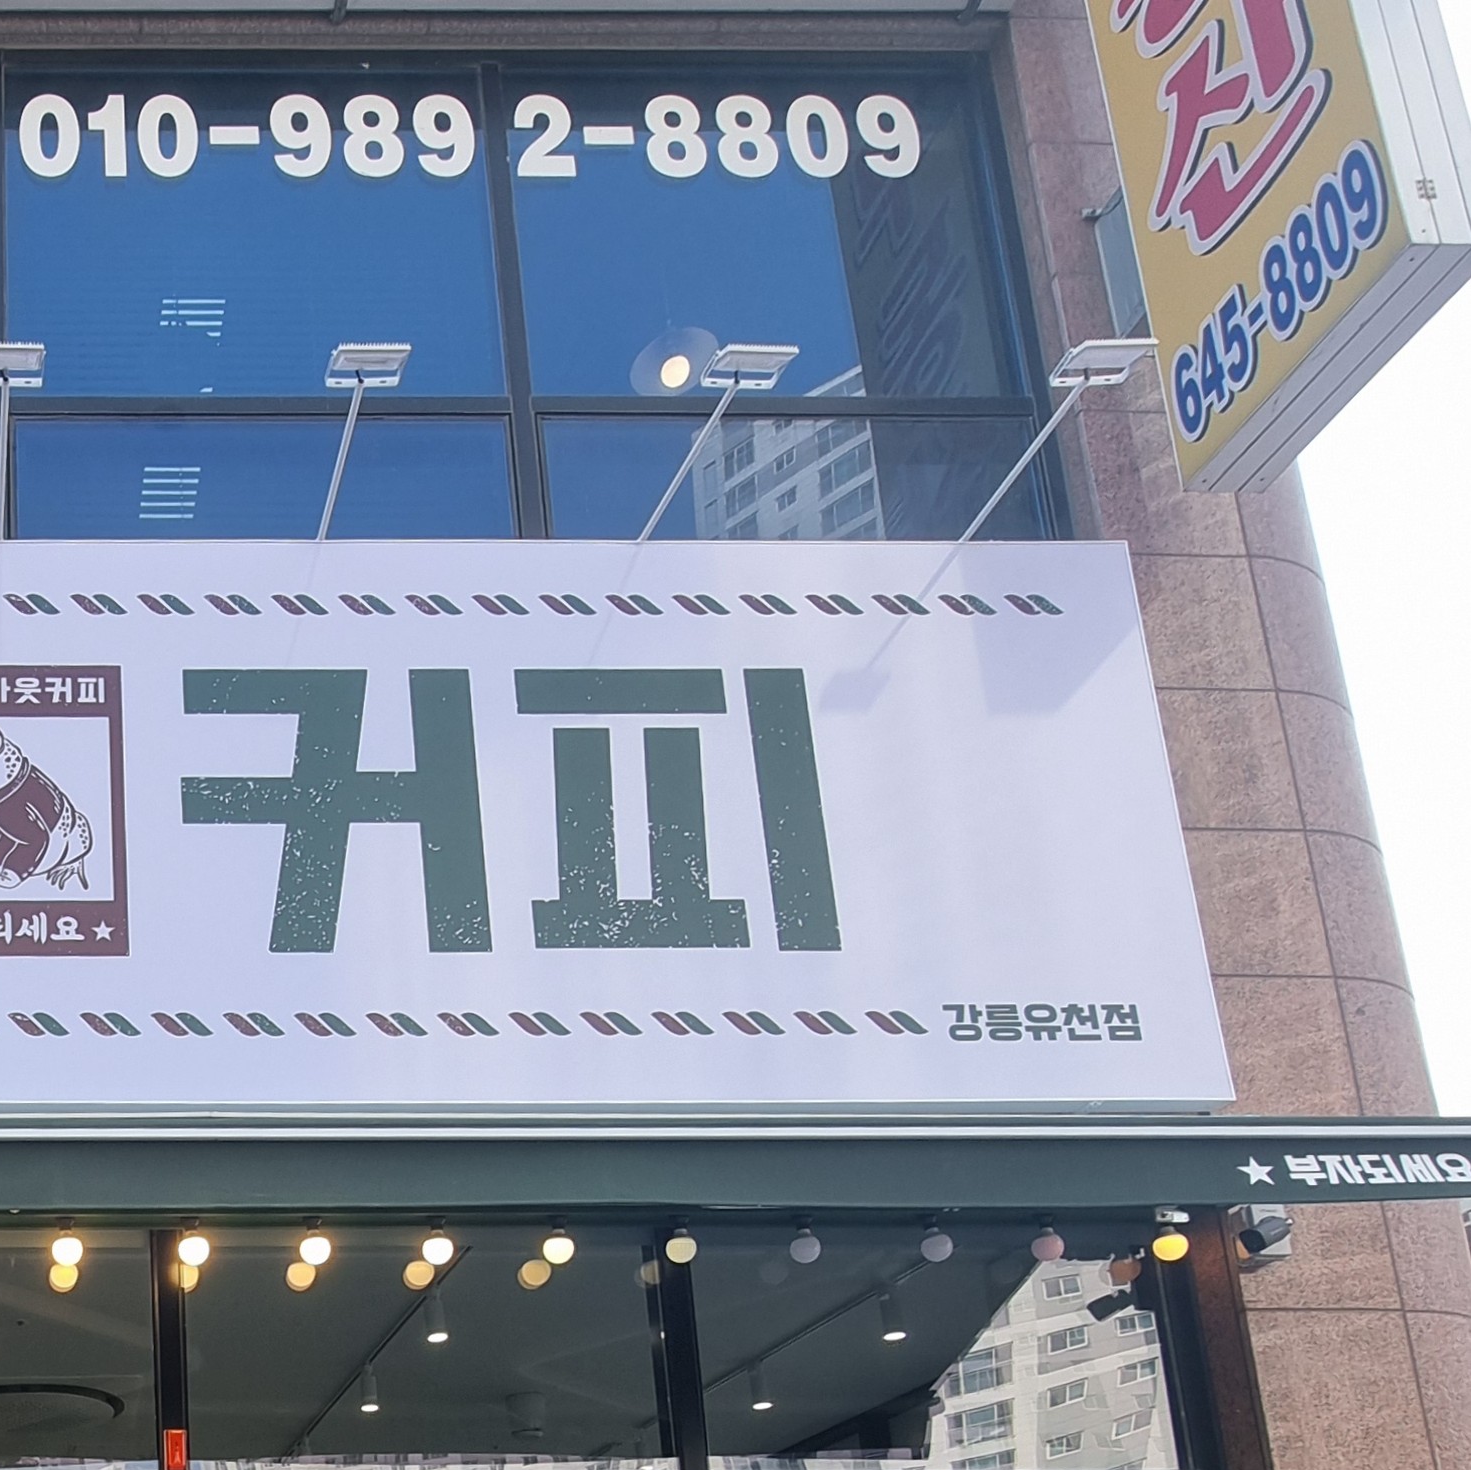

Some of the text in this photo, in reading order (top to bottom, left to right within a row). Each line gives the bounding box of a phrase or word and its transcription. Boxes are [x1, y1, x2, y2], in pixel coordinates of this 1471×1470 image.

[1172, 141, 1386, 441] 645-8809
[179, 667, 843, 954] 커피
[941, 1003, 1143, 1042] 강릉유천점
[1283, 1153, 1471, 1186] 부자되세요
